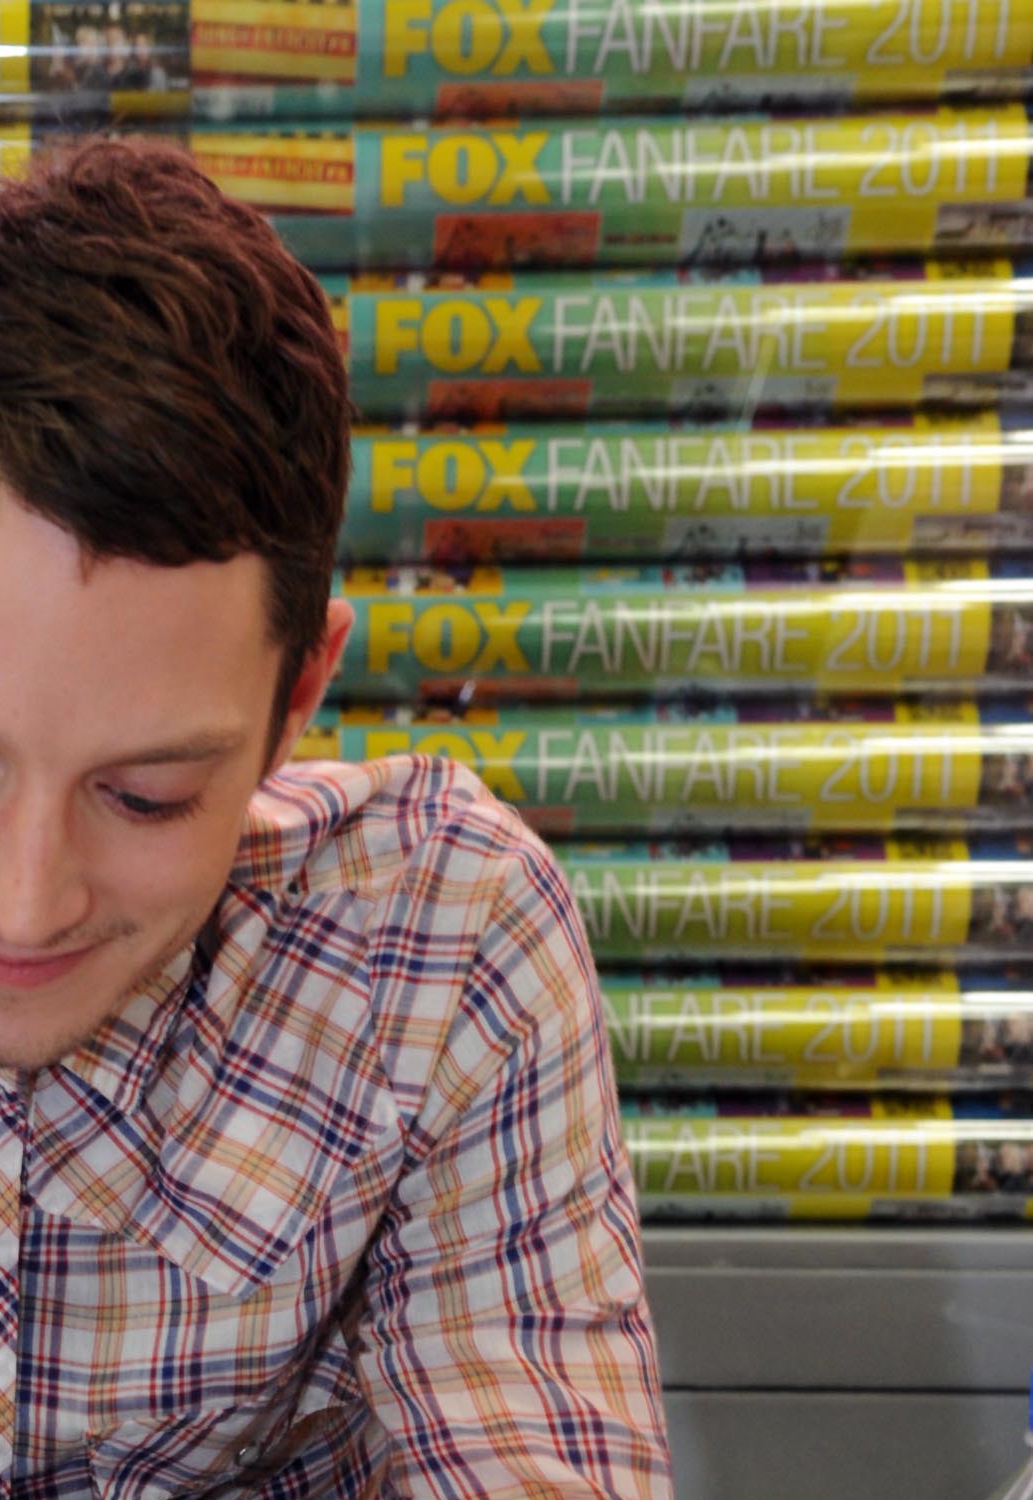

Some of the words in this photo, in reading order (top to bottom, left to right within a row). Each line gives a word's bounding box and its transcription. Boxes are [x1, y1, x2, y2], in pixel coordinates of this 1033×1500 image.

[381, 0, 554, 76] FOX
[567, 0, 850, 73] FANFARE
[865, 0, 1009, 63] 2011
[380, 133, 551, 206] FOX
[560, 124, 841, 204] FANFARE
[859, 118, 1000, 198] 2011
[374, 298, 543, 375] FOX
[551, 294, 829, 371] FANFARE
[845, 285, 987, 368] 2011
[371, 439, 537, 511] FOX
[545, 435, 821, 511] FANFARE
[835, 434, 973, 509] 2011
[368, 601, 531, 673] FOX
[539, 599, 810, 673] FANFARE
[825, 597, 963, 671] 2011
[537, 729, 808, 803] FANFARE
[821, 727, 955, 804] 2011
[572, 868, 795, 940] ANFARE
[811, 866, 945, 940] 2011
[601, 990, 786, 1062] NFARE
[802, 989, 936, 1063] 2011
[626, 1122, 781, 1193] FARE
[799, 1121, 929, 1193] 2011
